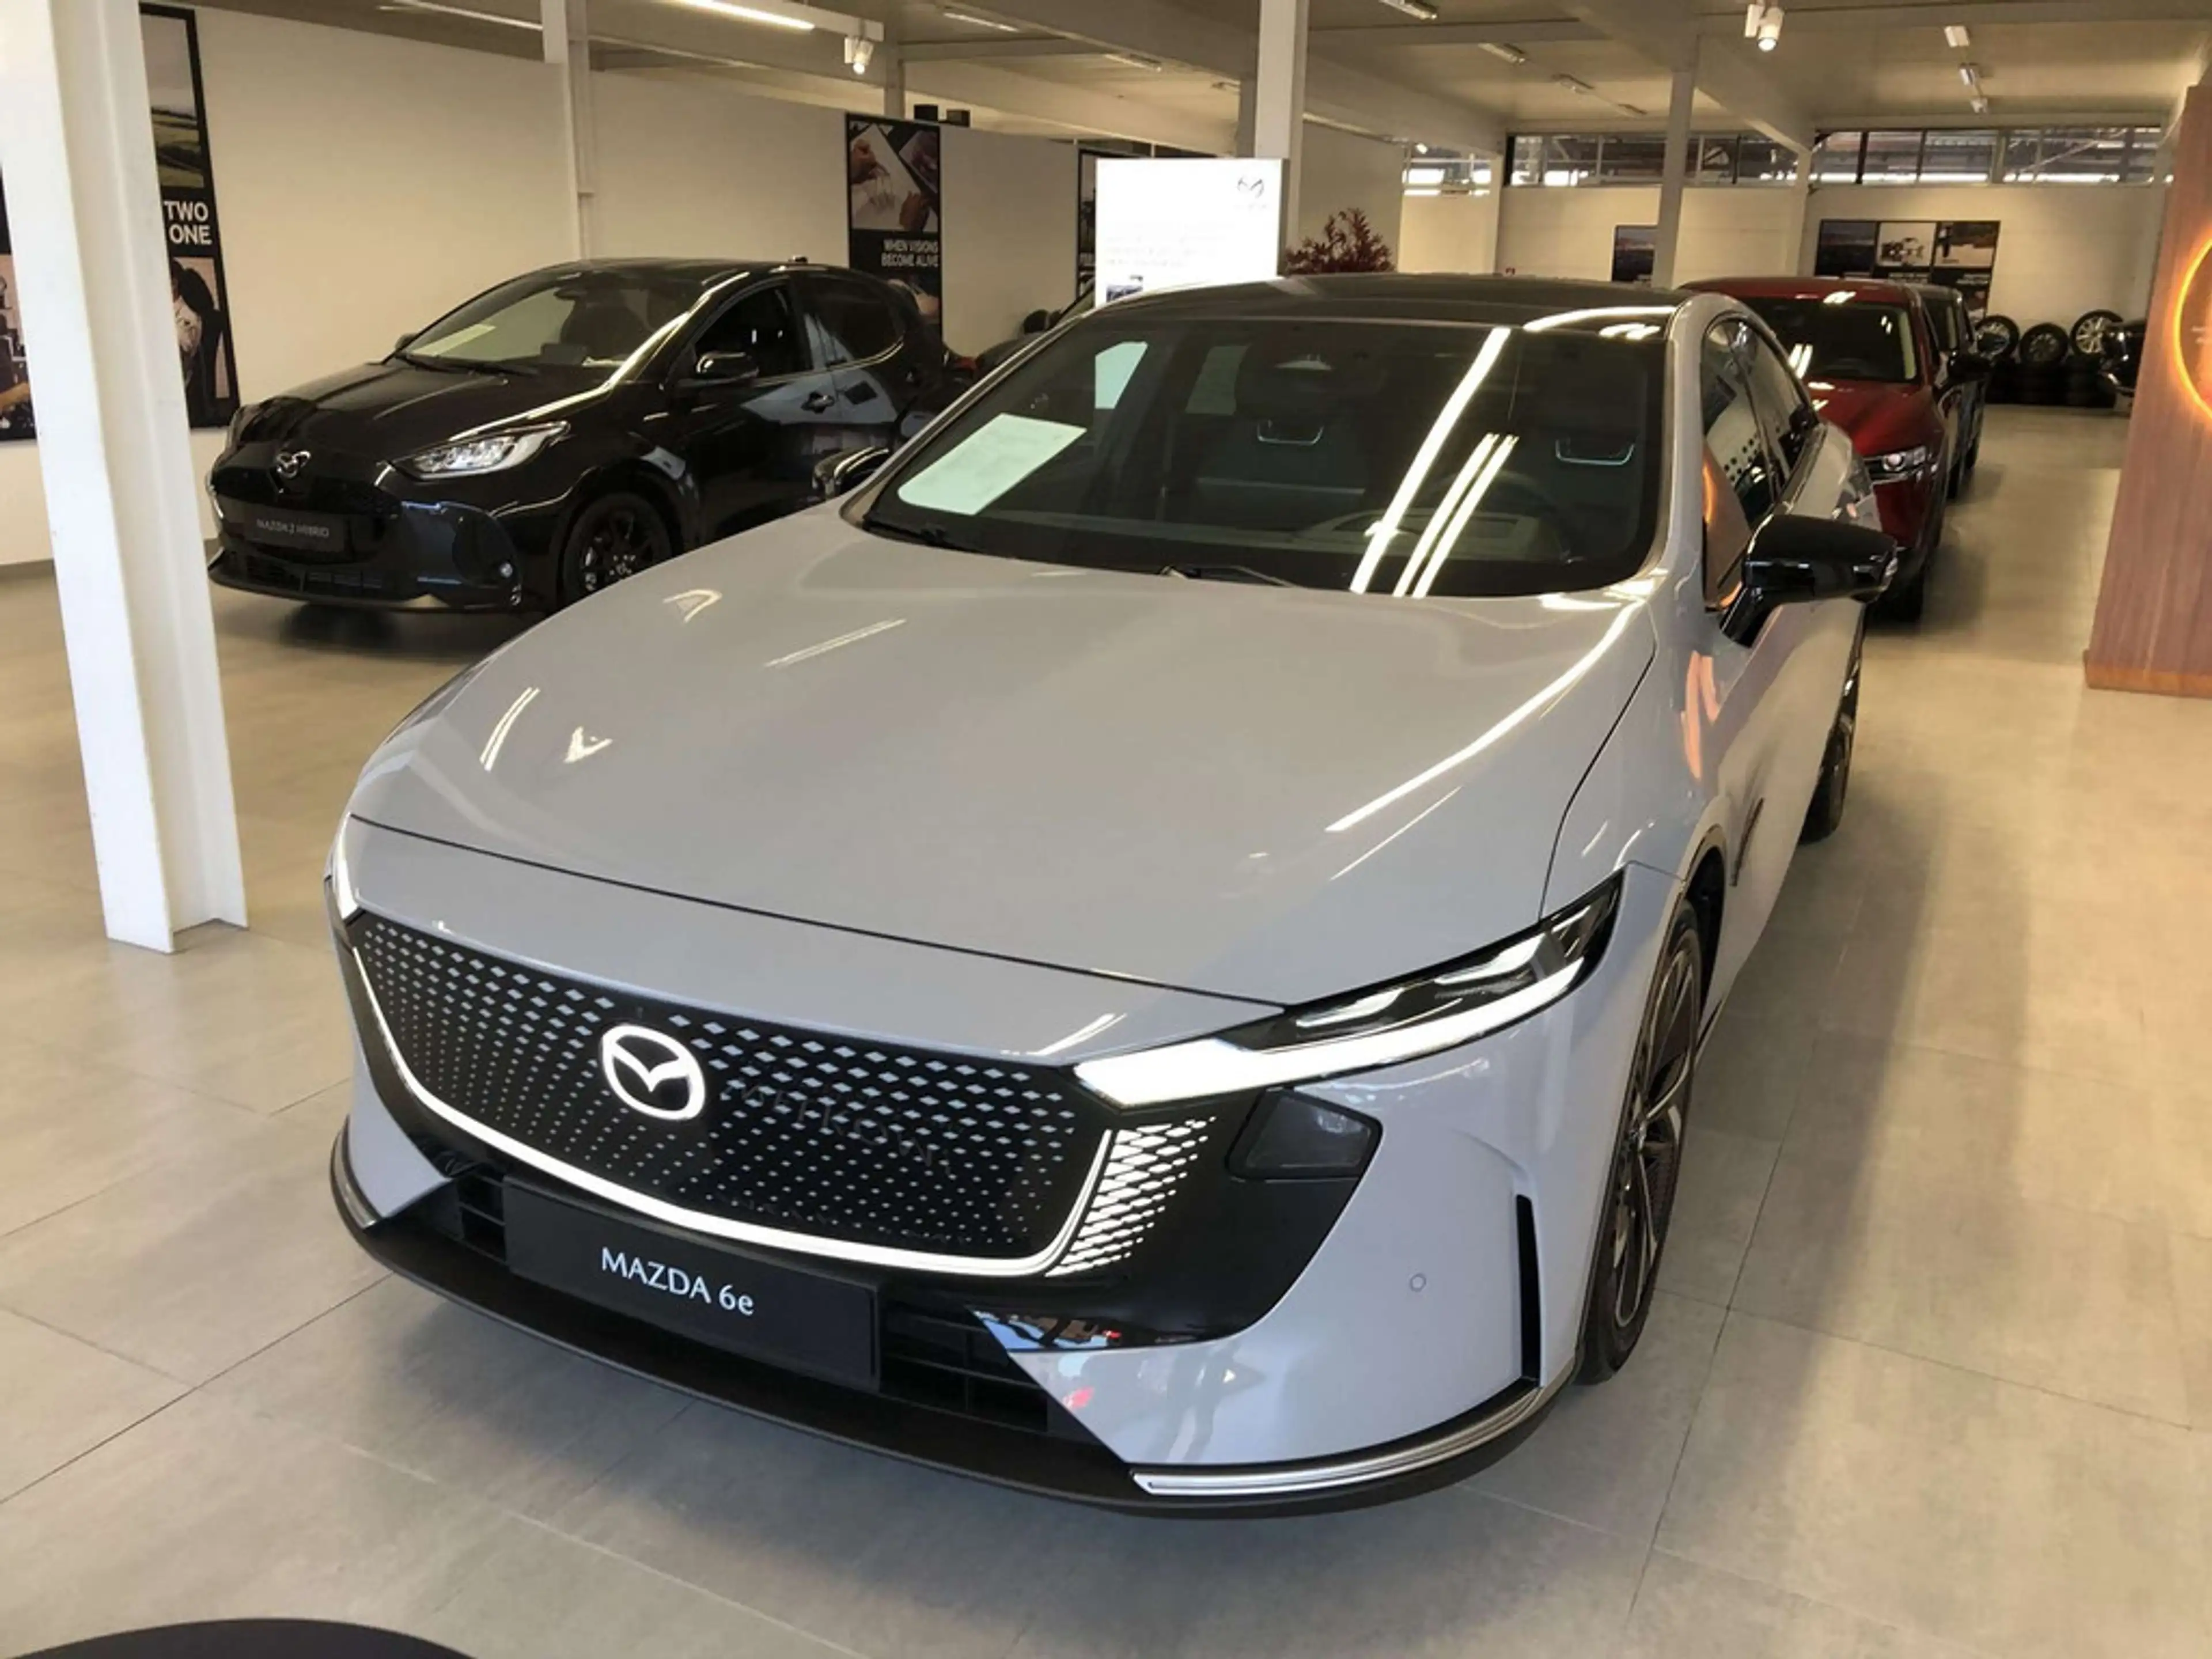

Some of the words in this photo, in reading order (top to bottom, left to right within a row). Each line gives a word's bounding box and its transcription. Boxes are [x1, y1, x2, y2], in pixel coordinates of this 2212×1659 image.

[164, 200, 209, 222] TWO
[169, 224, 212, 245] ONE
[601, 1246, 711, 1304] MAZDA
[719, 1284, 754, 1316] 6e
